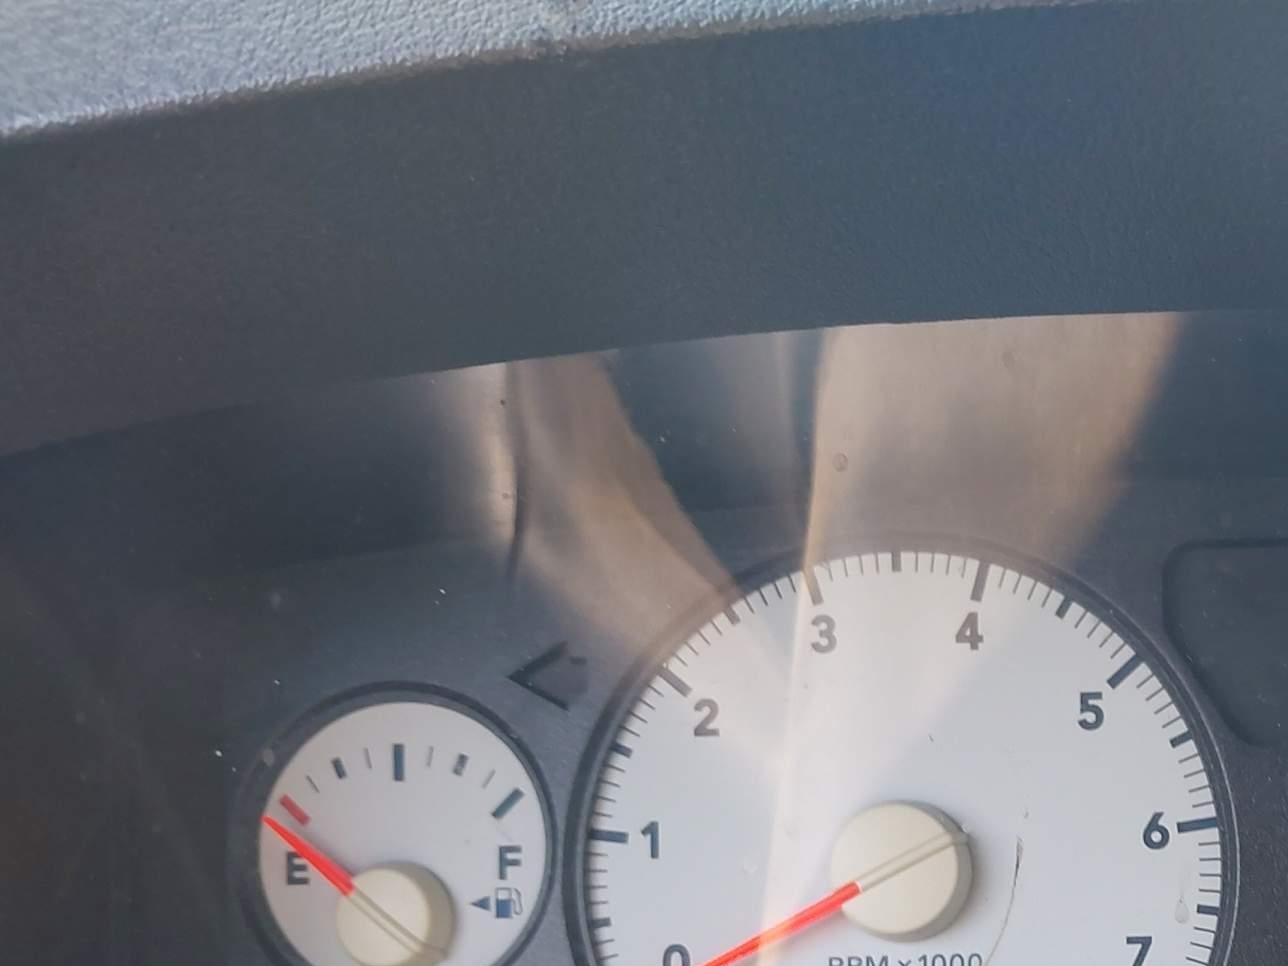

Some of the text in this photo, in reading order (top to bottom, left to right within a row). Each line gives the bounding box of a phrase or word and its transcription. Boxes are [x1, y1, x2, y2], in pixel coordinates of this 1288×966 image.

[809, 614, 838, 654] 3
[955, 611, 984, 651] 4
[692, 699, 720, 738] 2
[1077, 692, 1105, 731] 5
[640, 820, 661, 859] 1
[1142, 811, 1171, 850] 6
[285, 851, 310, 886] E
[499, 845, 523, 880] F
